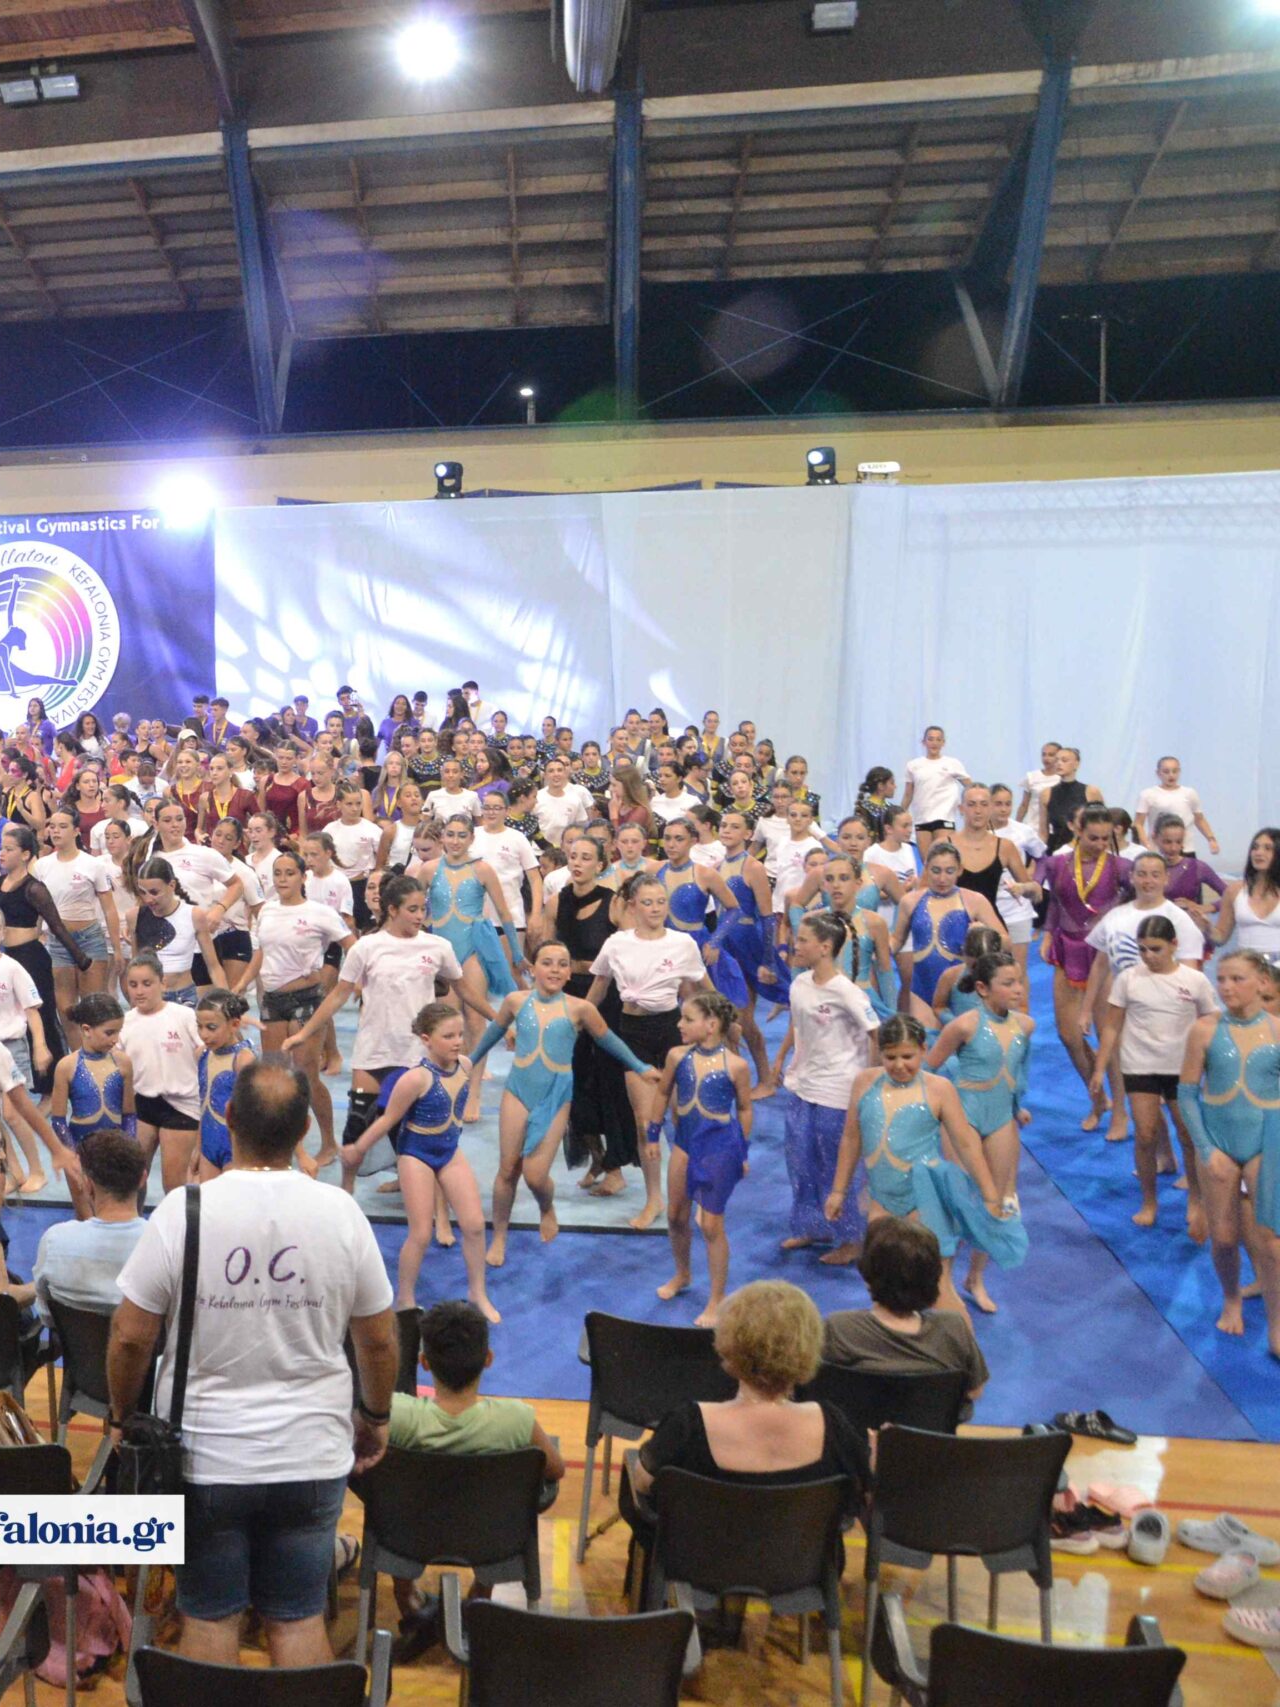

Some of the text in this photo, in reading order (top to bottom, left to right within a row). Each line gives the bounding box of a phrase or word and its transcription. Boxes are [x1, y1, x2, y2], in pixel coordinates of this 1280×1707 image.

[36, 516, 127, 537] Gymnastics
[132, 514, 161, 530] For
[49, 563, 111, 725] KEFALONIA GYM FESTIVA
